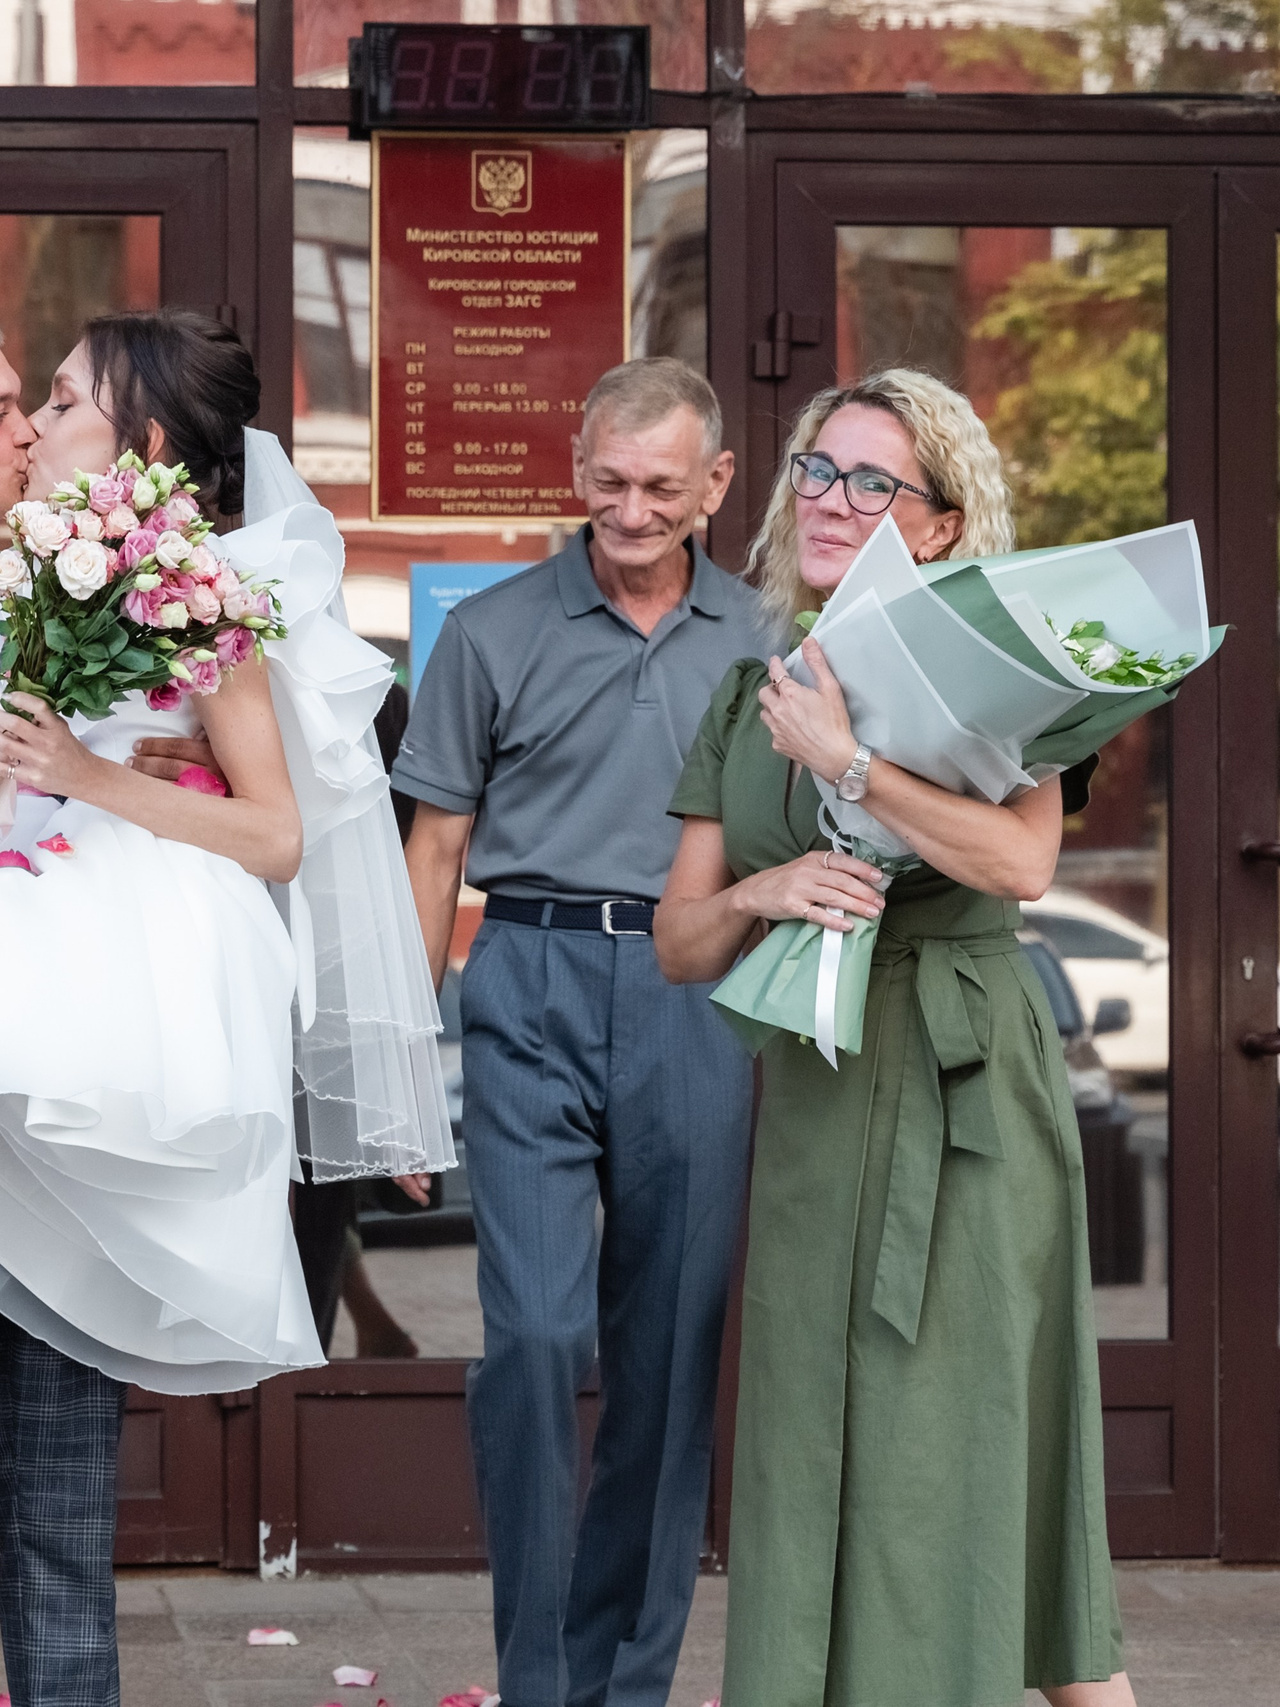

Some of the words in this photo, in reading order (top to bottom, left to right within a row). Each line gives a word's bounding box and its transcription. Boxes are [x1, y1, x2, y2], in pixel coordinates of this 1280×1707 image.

[406, 228, 523, 244] МИНИСТЕРСТВО
[527, 230, 598, 245] ЮСТИЦИИ
[423, 247, 511, 263] КИРОВСКОЙ
[513, 250, 581, 263] ОБЛАСТИ
[505, 295, 542, 308] ЗАГС
[500, 327, 550, 338] РАБОТЫ
[406, 342, 426, 354] ПН
[406, 362, 424, 375] ВТ
[406, 382, 426, 395] СР
[406, 402, 424, 414] ЧТ
[453, 401, 512, 413] ПЕРЕРЫВ
[406, 422, 424, 434] ПТ
[405, 442, 426, 454] СБ
[406, 462, 425, 474] ВС
[538, 488, 573, 499] МЕСЯ
